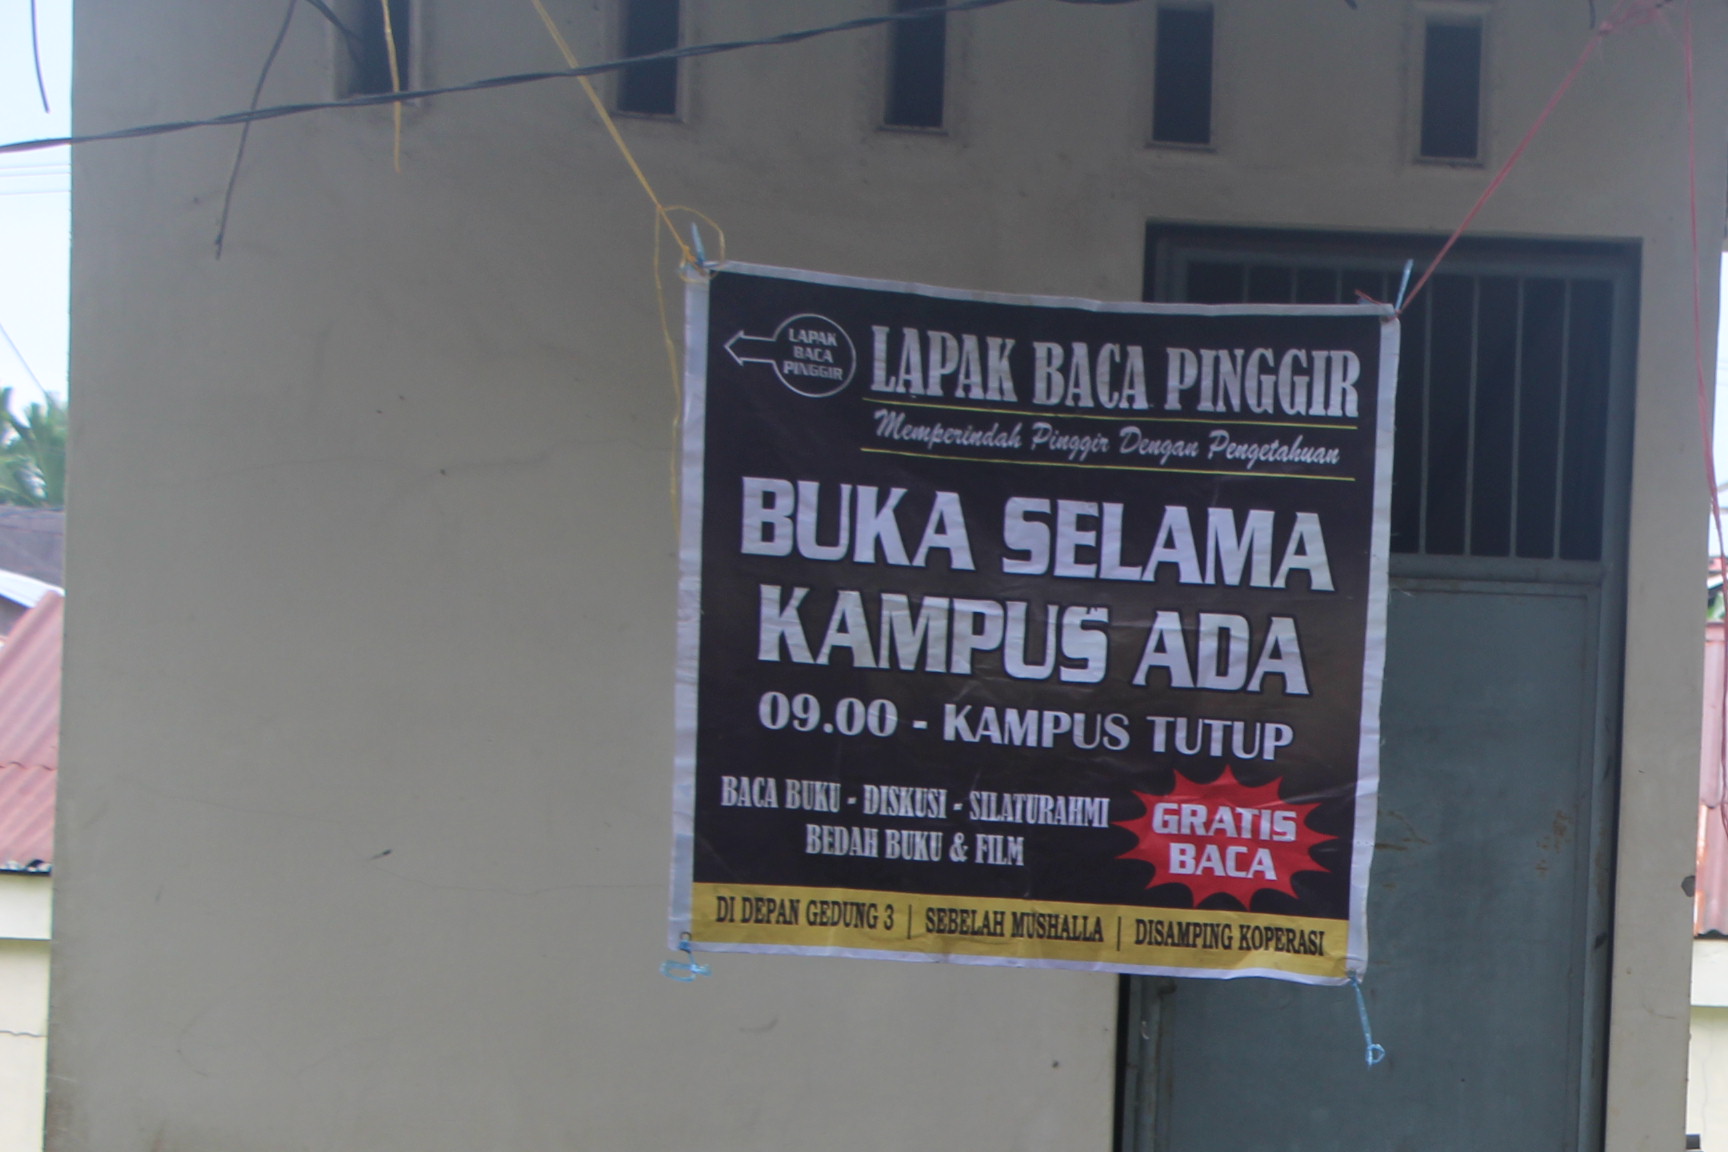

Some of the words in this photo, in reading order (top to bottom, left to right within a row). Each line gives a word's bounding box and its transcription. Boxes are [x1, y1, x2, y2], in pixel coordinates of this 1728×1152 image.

[788, 328, 838, 346] LAPAK
[793, 346, 834, 363] BACA
[783, 361, 843, 380] PINGGIR
[870, 325, 1018, 402] LAPAK
[1031, 341, 1149, 409] BACA
[1164, 347, 1361, 418] PINGGIR
[874, 409, 1023, 450] Memperindah
[1030, 422, 1110, 461] Pinggir
[1119, 426, 1199, 464] Dengan
[1207, 430, 1340, 469] Pengetahuan
[741, 476, 976, 570] BUKA
[1002, 496, 1335, 591] SELAMA
[758, 584, 1109, 683] KAMPUS
[1133, 611, 1310, 695] ADA
[759, 691, 898, 736] 09.00
[943, 704, 1130, 750] KAMPUS
[1146, 716, 1294, 760] TUTUP
[720, 776, 778, 809] BACA
[785, 779, 841, 812] BUKU
[862, 784, 948, 819] DISKUSI
[969, 791, 1110, 828] SILATURAHMI
[1152, 802, 1297, 842] GRATIS
[805, 823, 878, 858] BEDAH
[884, 829, 943, 862] BUKU
[949, 832, 968, 863] &
[975, 833, 1025, 866] FILM
[1169, 842, 1278, 881] BACA
[716, 896, 735, 923] DI
[741, 896, 800, 926] DEPAN
[806, 900, 878, 930] GEDUNG
[884, 904, 894, 930] 3
[925, 908, 1005, 938] SEBELAH
[1011, 911, 1104, 942] MUSHALLA
[1135, 919, 1233, 950] DISAMPING
[1238, 924, 1325, 956] KOPERASI
